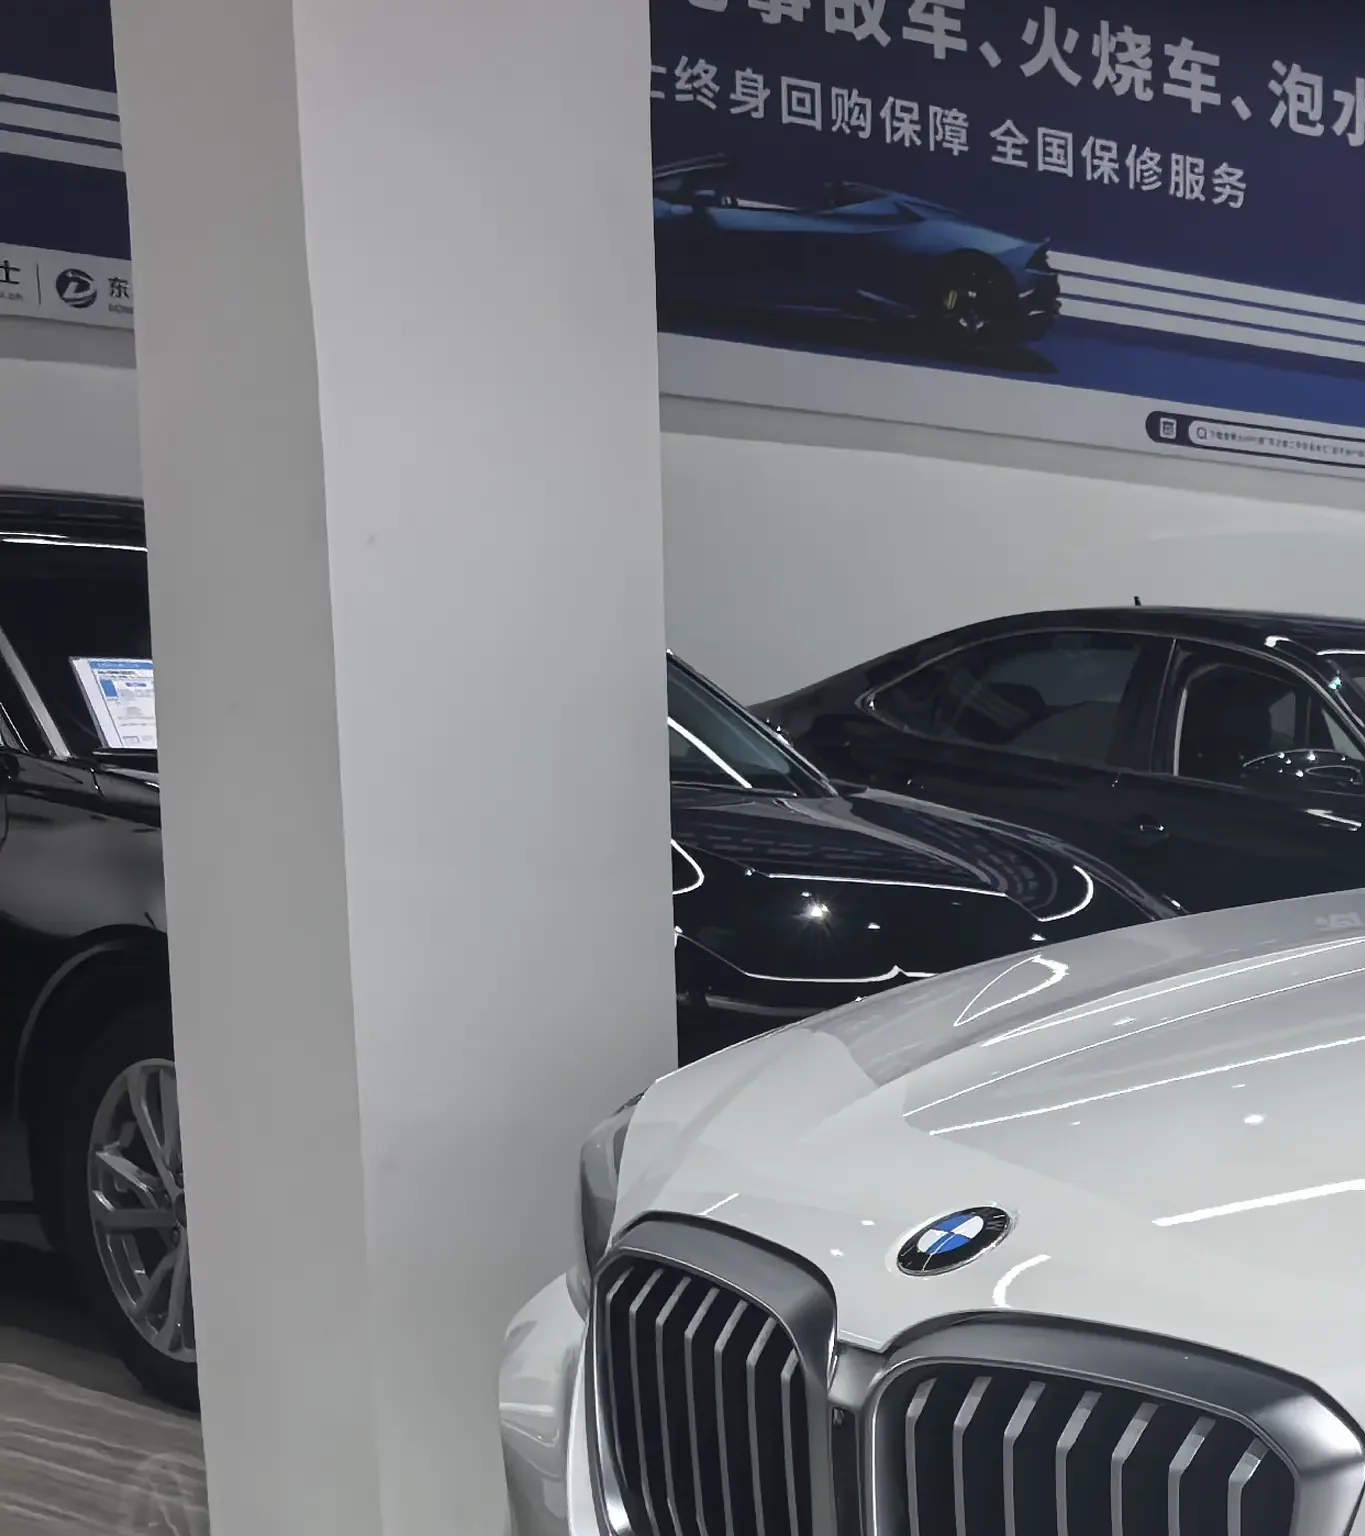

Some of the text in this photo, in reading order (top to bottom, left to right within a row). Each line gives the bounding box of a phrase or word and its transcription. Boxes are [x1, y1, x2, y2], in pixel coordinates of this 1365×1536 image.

[989, 119, 1248, 209] 全国保修服务
